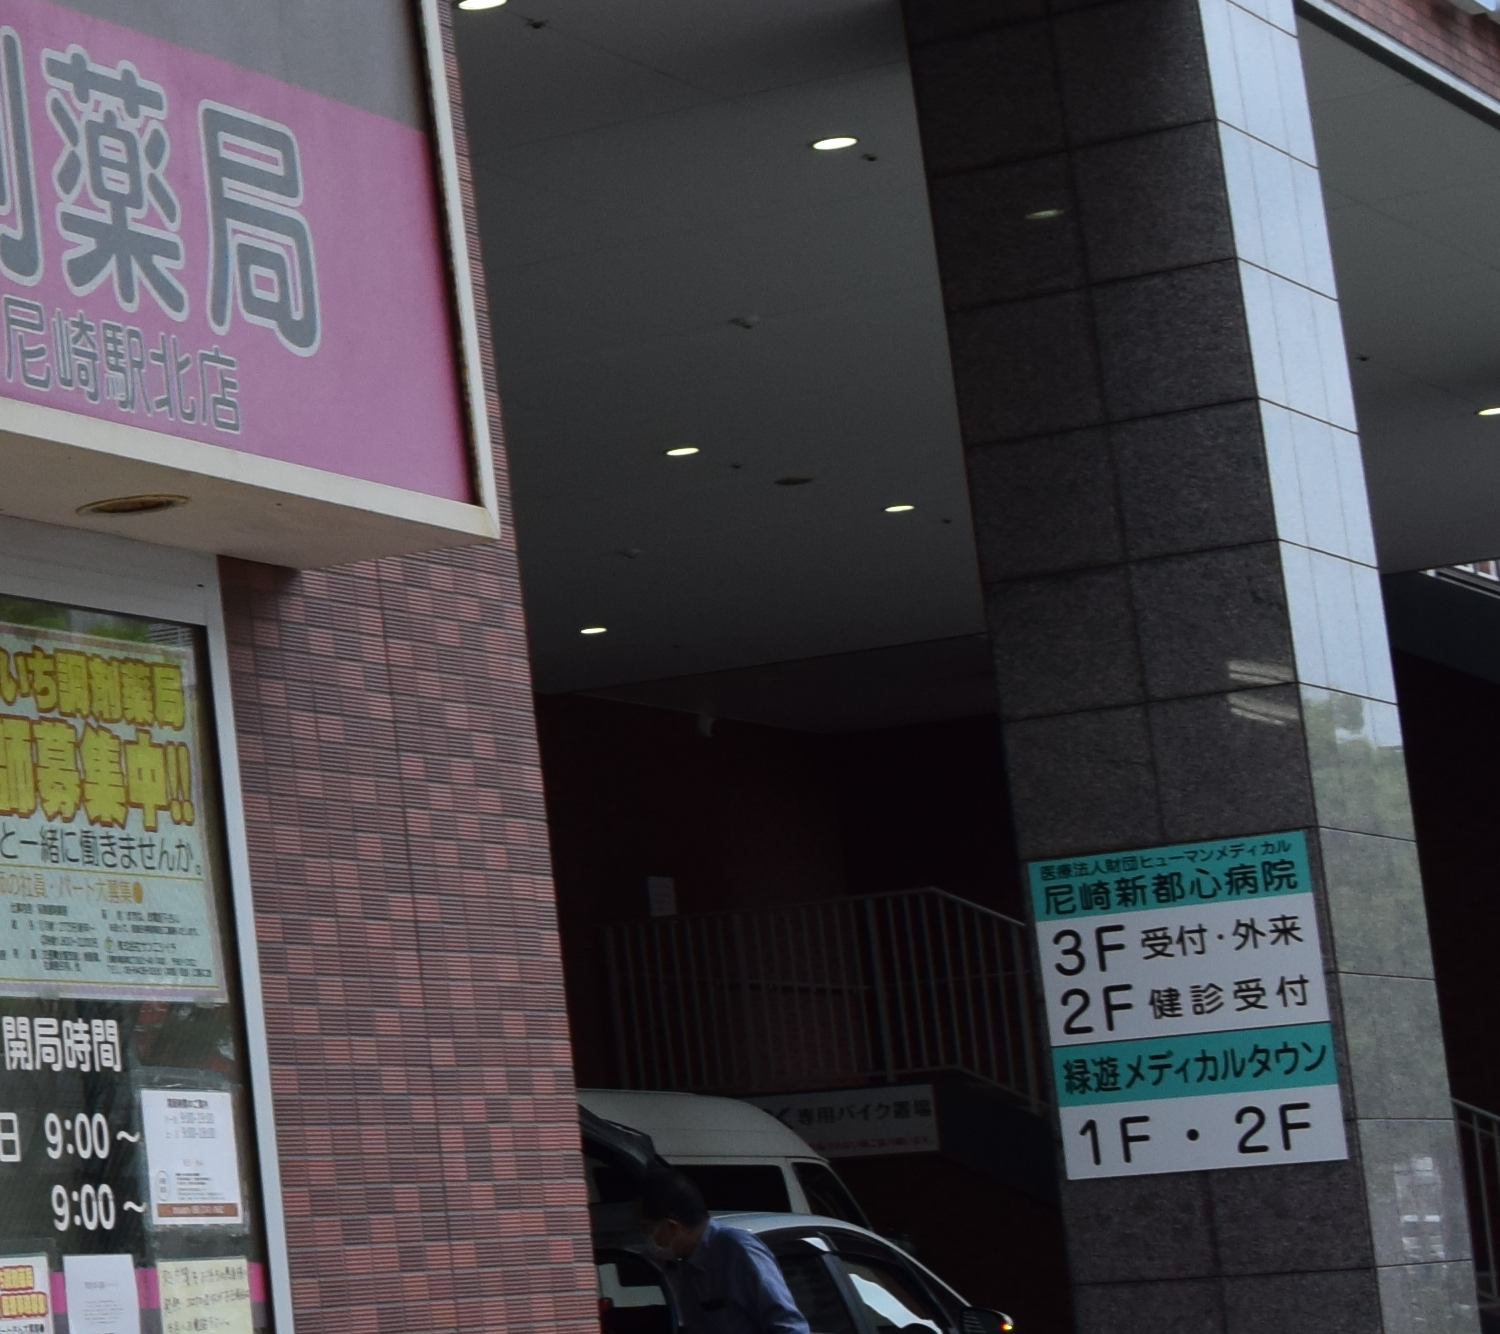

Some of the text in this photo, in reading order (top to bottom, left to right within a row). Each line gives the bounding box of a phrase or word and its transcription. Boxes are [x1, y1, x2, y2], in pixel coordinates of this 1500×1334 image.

[1040, 839, 1291, 881] 医療法人財団ヒューマンメディカル
[1044, 859, 1299, 916] 尼崎新都心病院
[1052, 914, 1304, 976] 3F 受付・外来
[1060, 974, 1311, 1035] 2F 健診受付
[2, 1016, 123, 1073] 開局時間
[1062, 1041, 1328, 1094] 緑遊メディカルタウン
[1079, 1115, 1150, 1166] 1F
[1234, 1102, 1311, 1154] 2F
